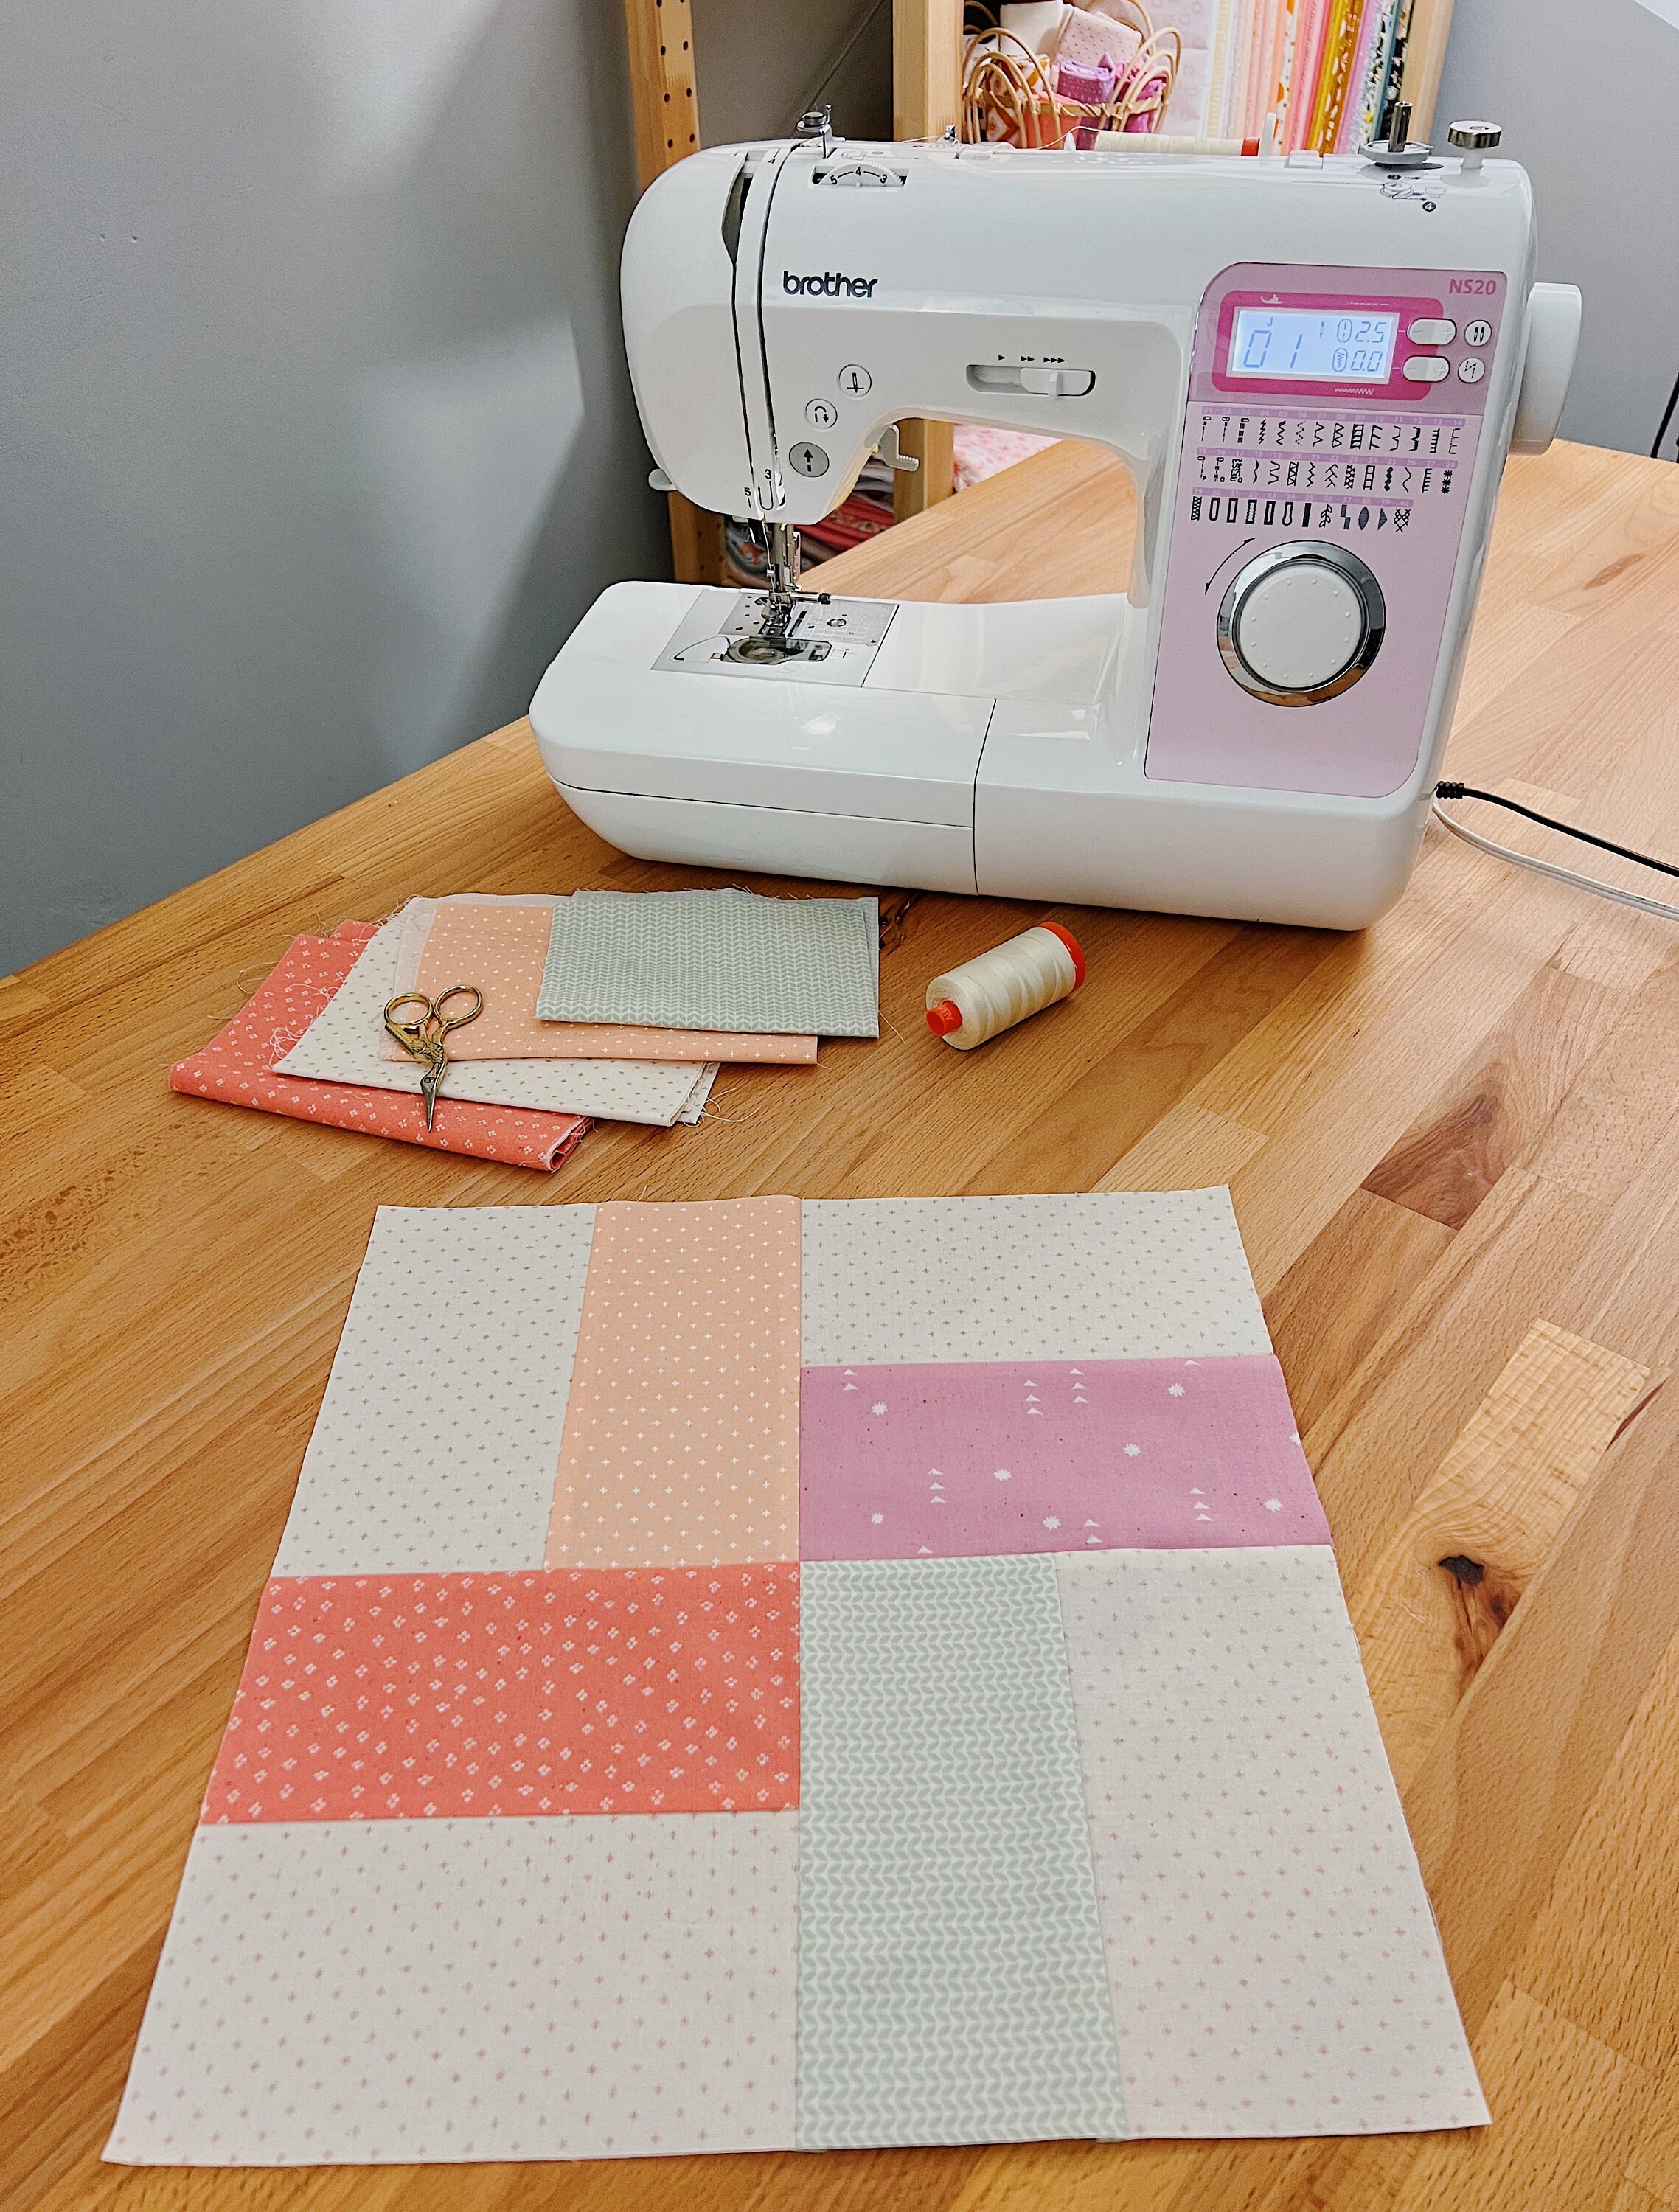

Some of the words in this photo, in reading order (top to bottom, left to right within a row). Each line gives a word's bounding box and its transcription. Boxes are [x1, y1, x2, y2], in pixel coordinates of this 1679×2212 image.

[830, 175, 838, 185] 5
[855, 167, 862, 176] 4
[880, 174, 888, 184] 3
[1424, 202, 1433, 211] 4
[783, 271, 877, 298] brother
[1449, 279, 1496, 295] NS20
[1267, 317, 1273, 327] J
[1355, 321, 1387, 343] 2.5
[1243, 330, 1303, 369] 01
[1351, 350, 1383, 372] 0.0
[765, 468, 771, 479] 3
[744, 487, 751, 497] 5
